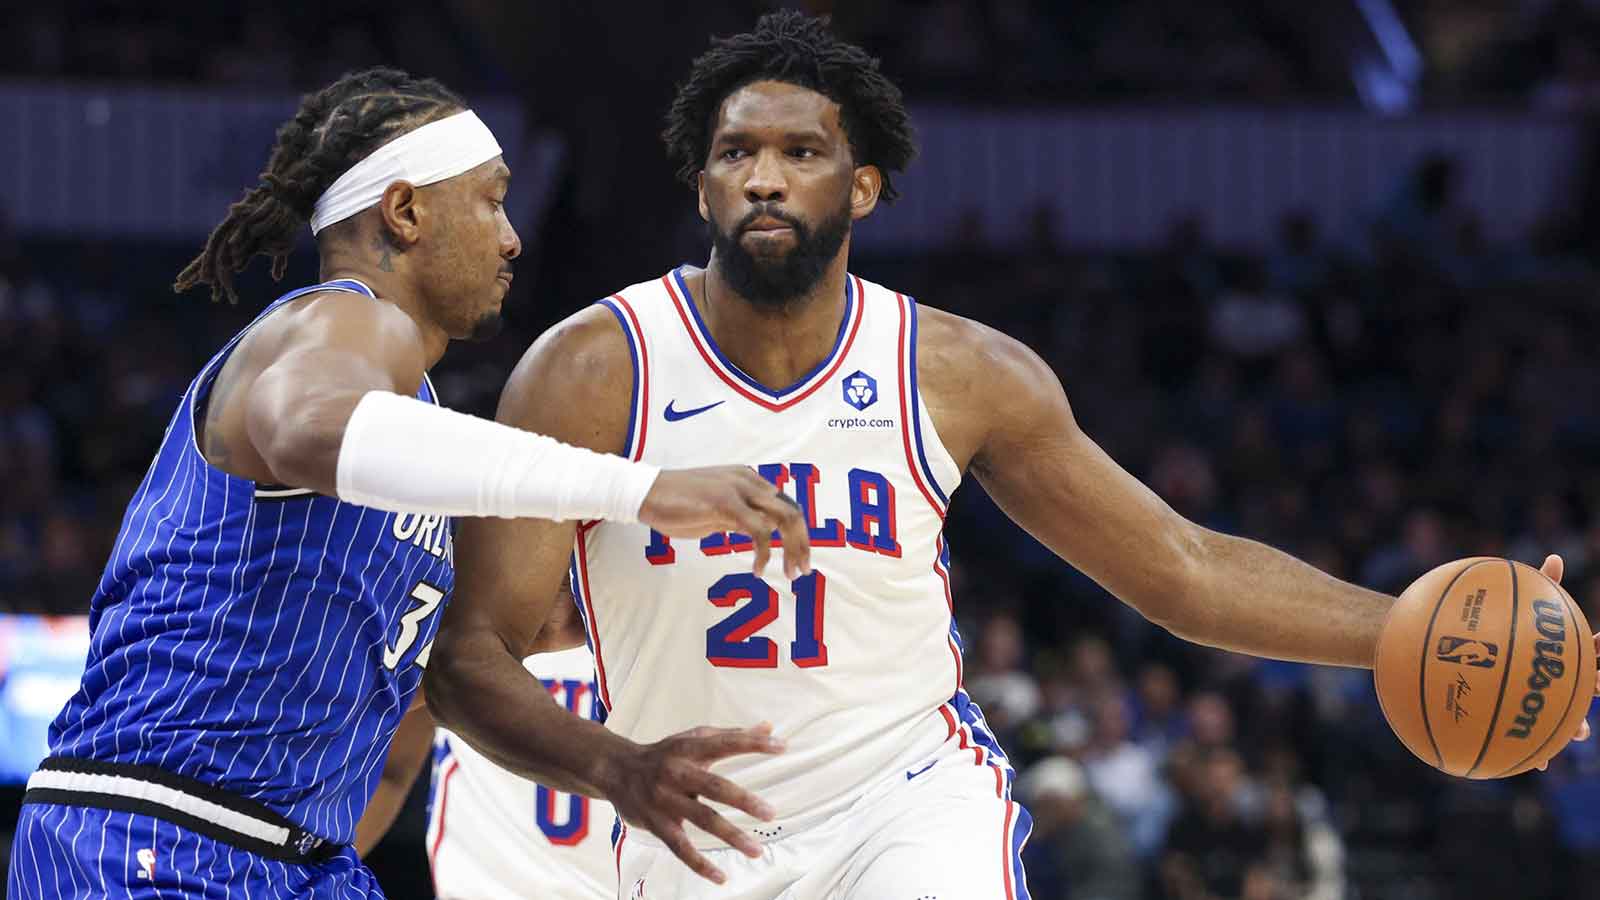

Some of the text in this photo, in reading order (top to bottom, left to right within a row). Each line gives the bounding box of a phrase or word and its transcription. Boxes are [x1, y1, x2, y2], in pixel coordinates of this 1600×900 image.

[827, 417, 894, 429] crypto.com
[705, 569, 828, 668] 21
[1504, 599, 1566, 739] Wilson
